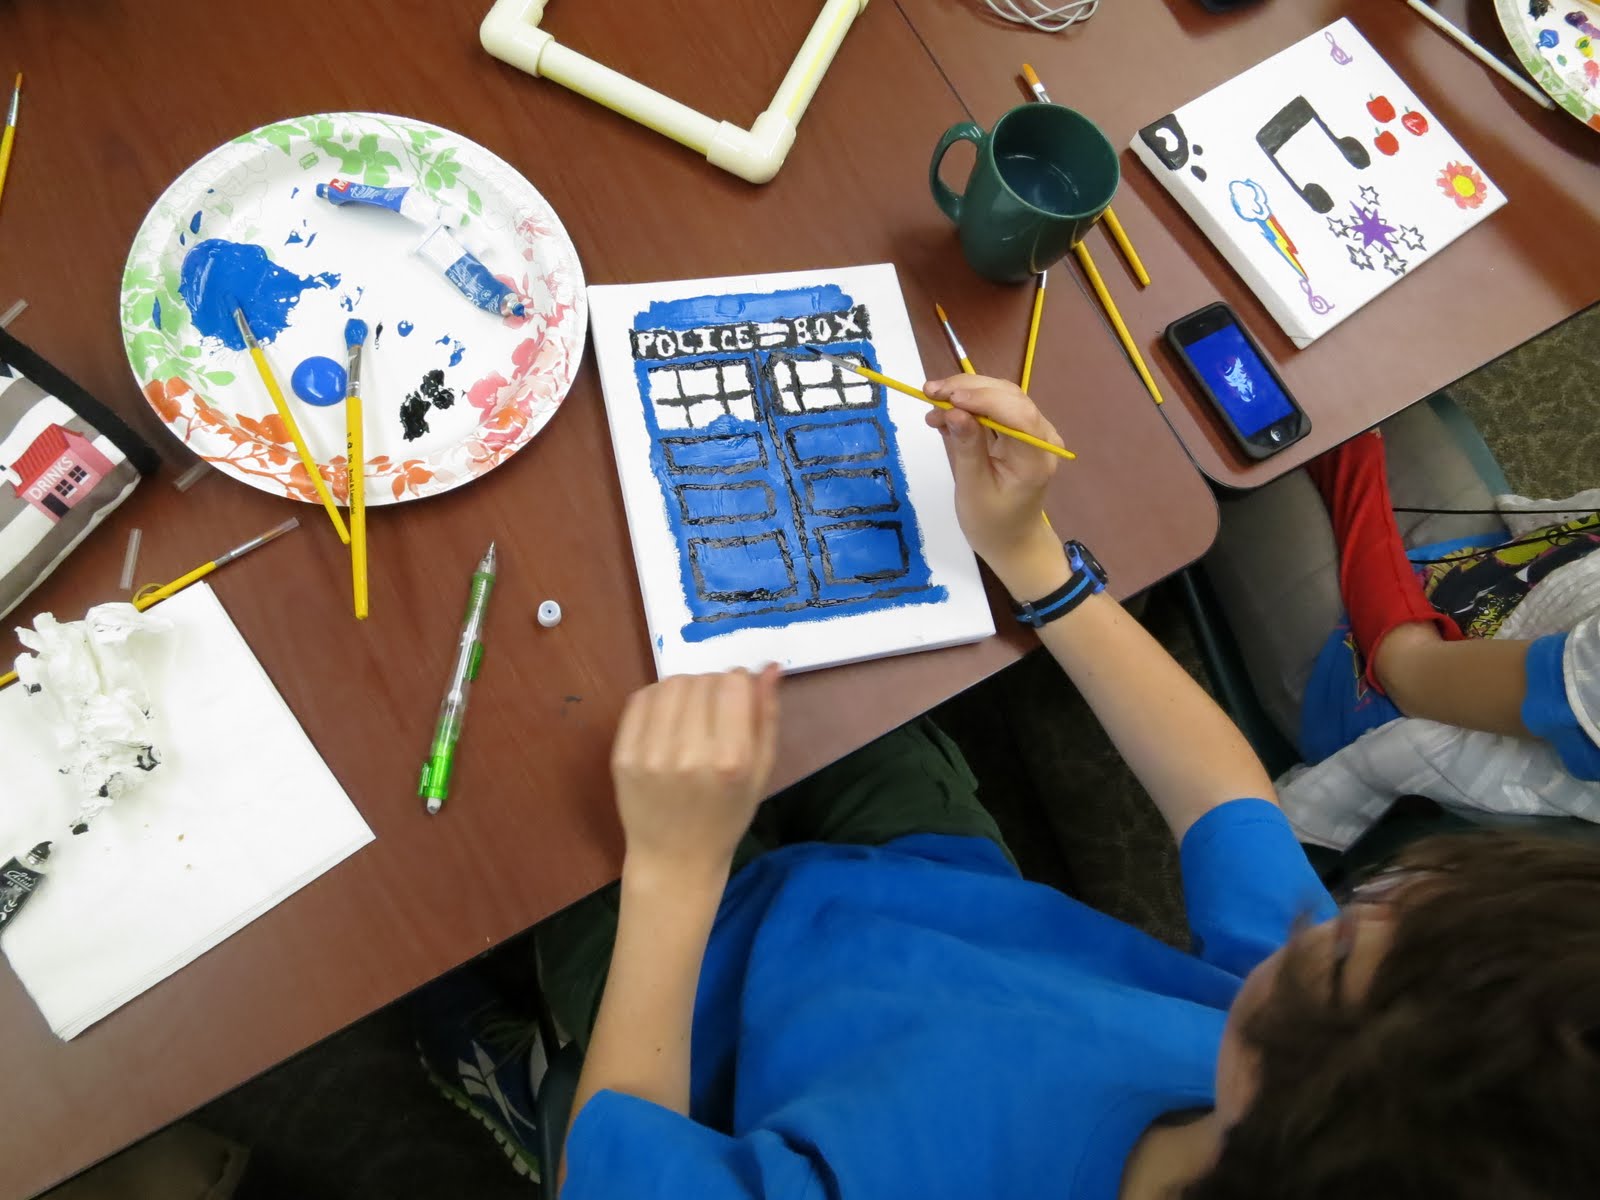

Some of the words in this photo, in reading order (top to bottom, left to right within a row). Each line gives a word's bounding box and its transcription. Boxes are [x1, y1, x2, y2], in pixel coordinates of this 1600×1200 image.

[636, 326, 754, 358] POLICE
[794, 308, 863, 344] BOX
[28, 456, 74, 501] DRINKS
